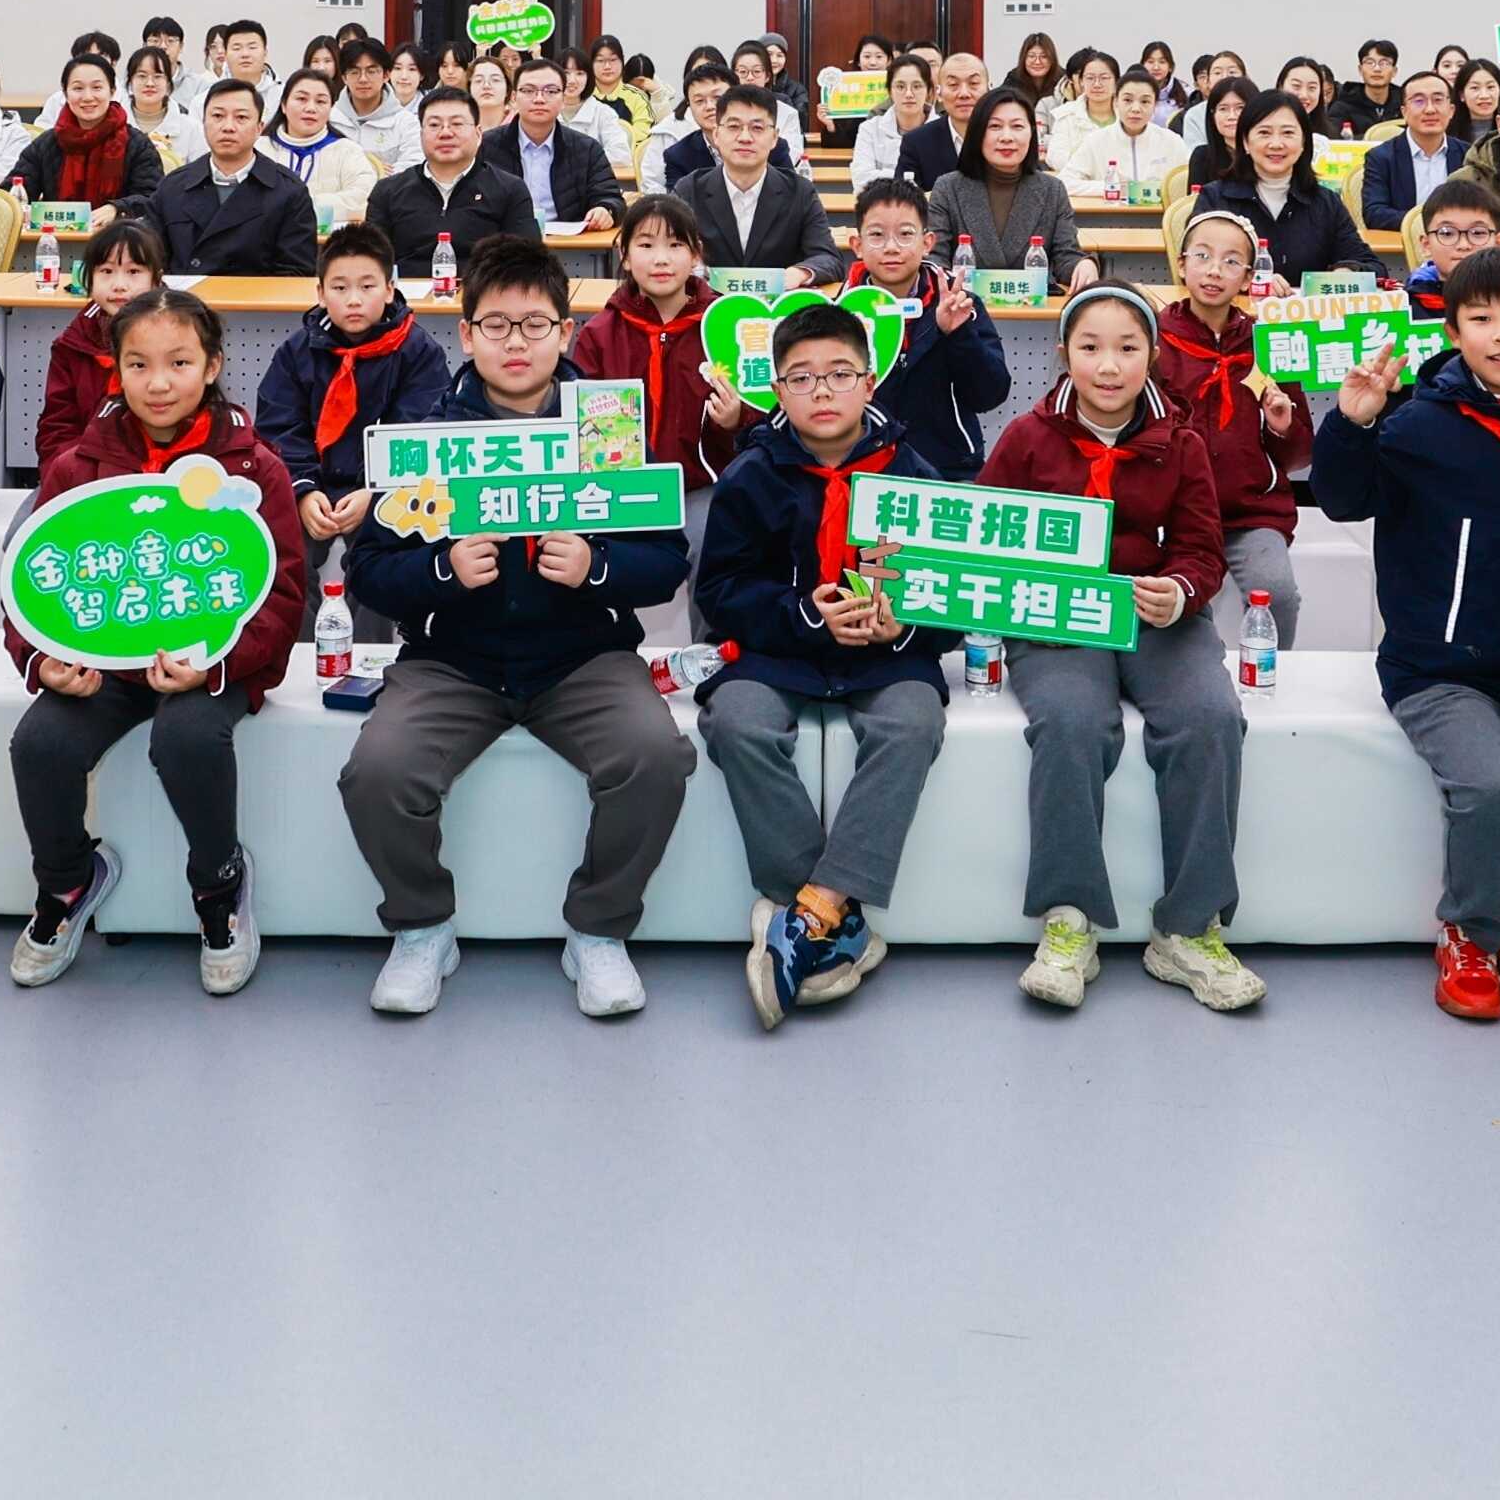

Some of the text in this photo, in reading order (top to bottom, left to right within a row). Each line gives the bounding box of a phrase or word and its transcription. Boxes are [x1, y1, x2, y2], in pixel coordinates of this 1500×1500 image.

[727, 280, 767, 292] 石长胜
[989, 282, 1030, 294] 胡艳华
[389, 433, 569, 477] 胸怀天下
[480, 482, 659, 525] 知行合一
[876, 490, 1082, 555] 科普报国
[28, 531, 226, 592] 金种童心
[63, 568, 244, 629] 智启未来
[901, 568, 1112, 635] 实干担当
